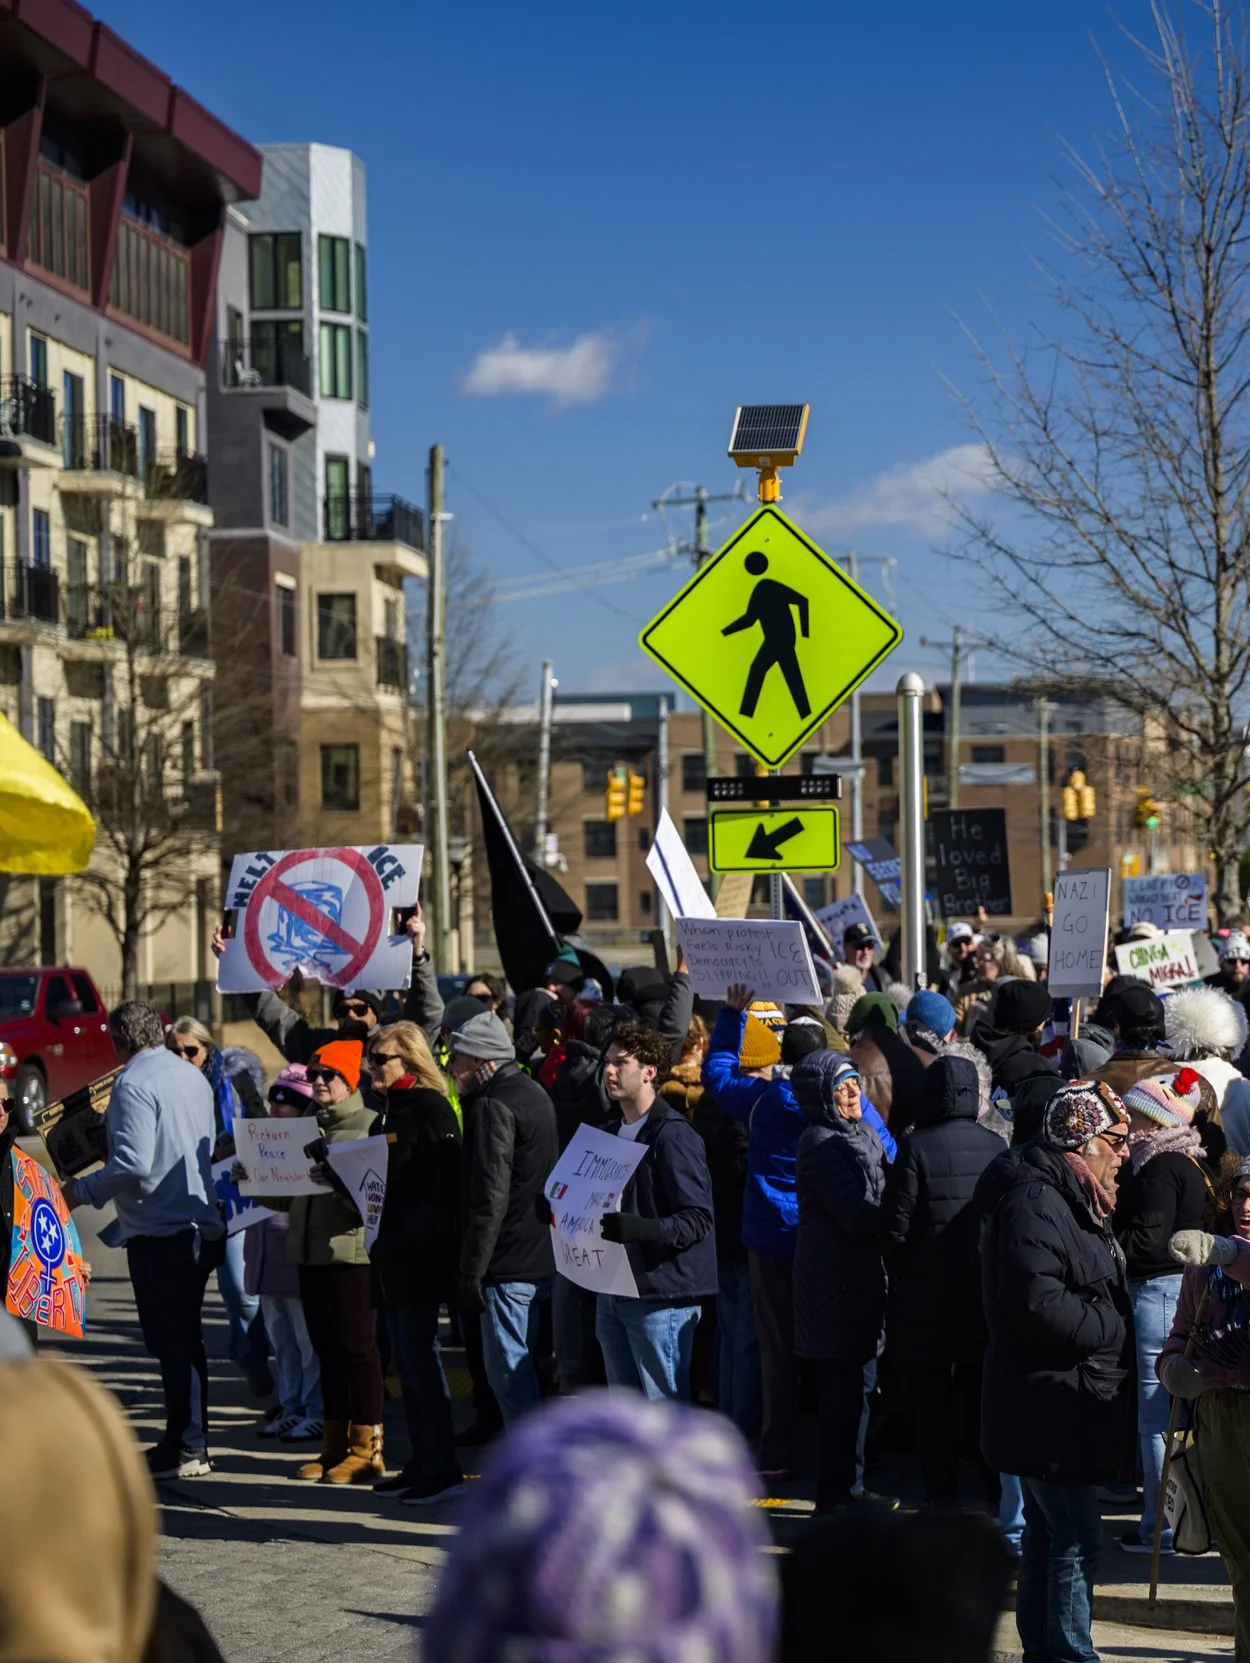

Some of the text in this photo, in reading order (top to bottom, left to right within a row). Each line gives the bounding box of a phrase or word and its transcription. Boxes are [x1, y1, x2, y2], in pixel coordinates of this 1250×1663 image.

[950, 814, 982, 839] He
[939, 842, 1003, 867] loved
[233, 852, 277, 907] MELT
[367, 846, 406, 891] ICE
[954, 867, 990, 891] Big
[1057, 881, 1097, 900] NAZI
[1062, 913, 1088, 935] GO
[1163, 904, 1201, 924] ICE
[679, 922, 774, 940] When protest
[770, 941, 804, 963] ICE
[1054, 950, 1101, 972] HOME
[776, 969, 809, 986] OUT
[248, 1122, 291, 1141] Return
[258, 1143, 286, 1160] Peace
[253, 1168, 269, 1182] Our
[561, 1240, 605, 1268] GREAT
